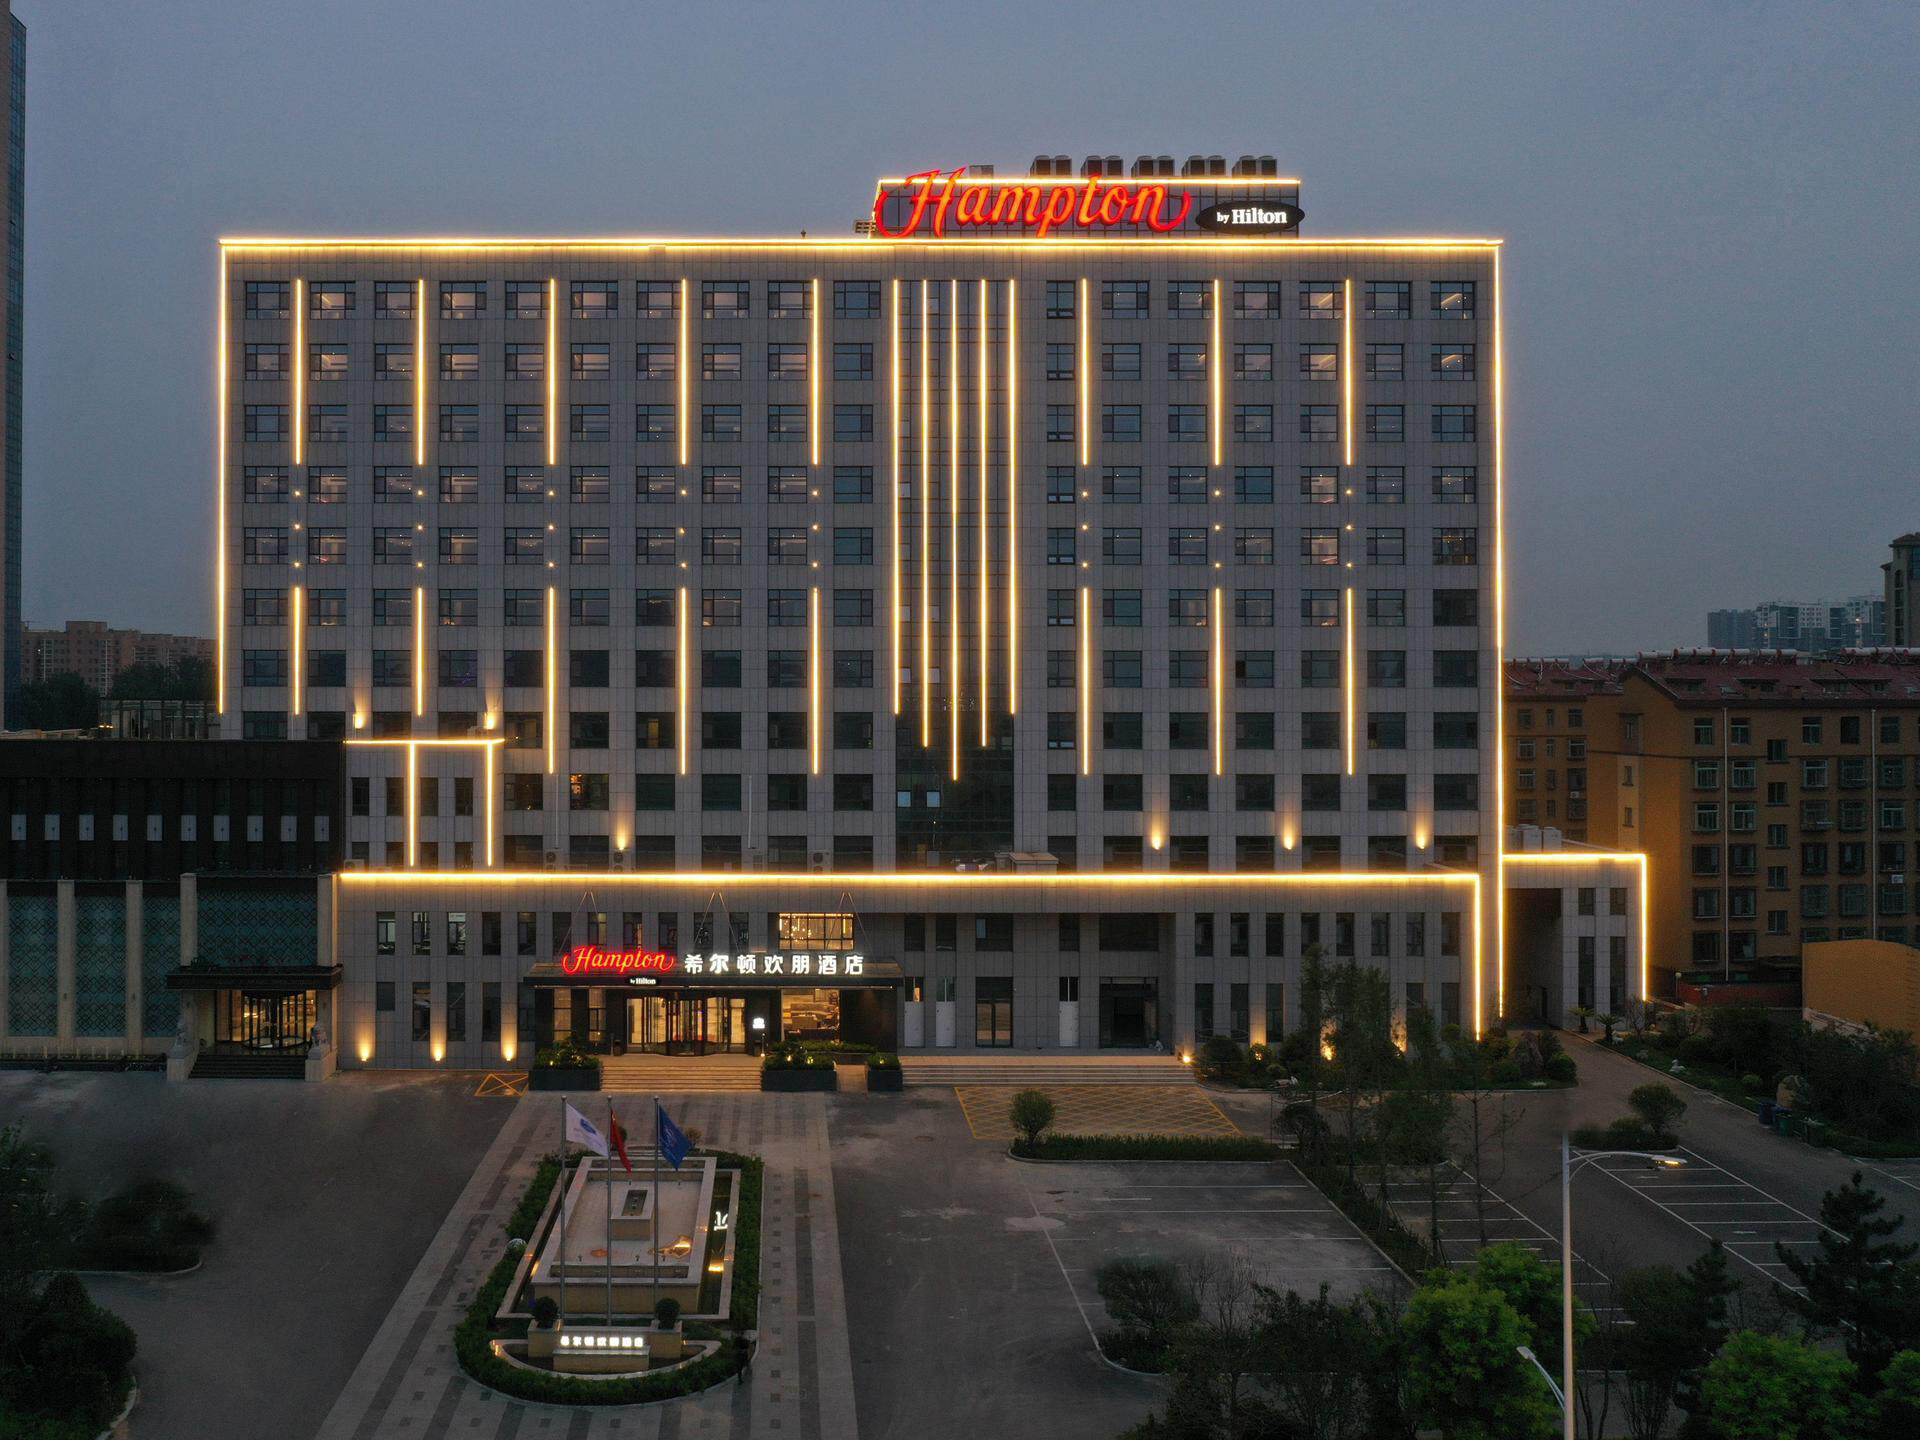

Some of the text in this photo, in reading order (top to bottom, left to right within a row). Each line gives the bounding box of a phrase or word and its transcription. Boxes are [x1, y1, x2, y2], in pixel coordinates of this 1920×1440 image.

[875, 167, 1191, 238] Hampton
[1216, 207, 1288, 225] by Hilton
[562, 945, 674, 975] Hampton
[684, 953, 864, 975] 希尔顿欢朋酒店
[635, 977, 657, 985] Hilton
